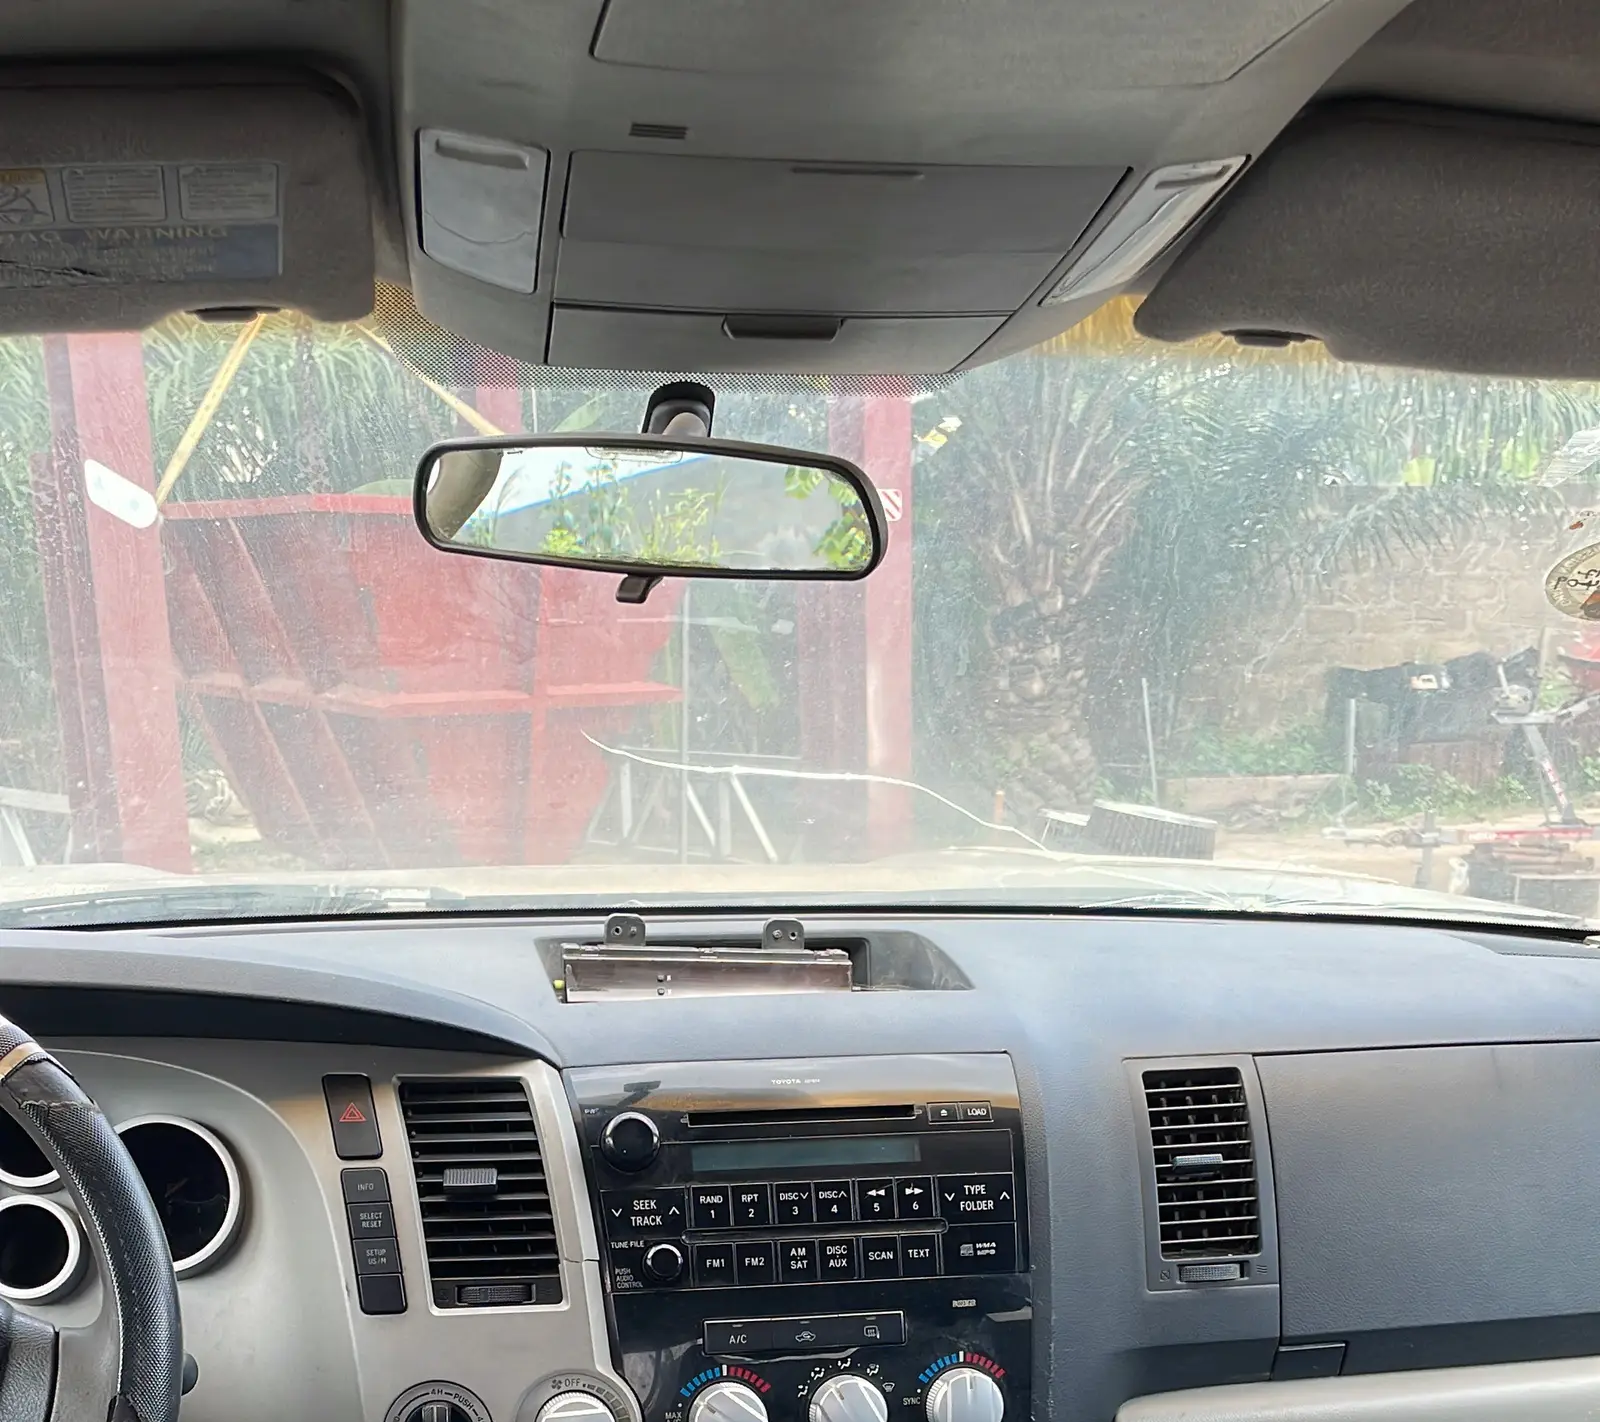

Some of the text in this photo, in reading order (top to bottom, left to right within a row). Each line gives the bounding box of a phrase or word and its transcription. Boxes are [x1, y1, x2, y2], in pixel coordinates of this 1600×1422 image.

[967, 1107, 987, 1117] LOAD
[357, 1183, 374, 1191] INFO
[964, 1185, 987, 1195] TYPE
[741, 1194, 759, 1203] RPT
[779, 1192, 799, 1201] DISC
[818, 1190, 838, 1199] DISC
[700, 1195, 723, 1204] RAND
[633, 1200, 657, 1211] SEEK
[830, 1205, 838, 1214] 4
[873, 1203, 880, 1212] 5
[912, 1201, 919, 1210] 6
[960, 1200, 994, 1212] FOLDER
[710, 1210, 715, 1219] 1
[748, 1209, 755, 1218] 2
[792, 1206, 799, 1215] 3
[359, 1212, 383, 1221] SELECT
[361, 1220, 383, 1228] RESET
[630, 1216, 663, 1227] TRACK
[366, 1248, 387, 1257] SETUP
[790, 1247, 806, 1257] AM
[826, 1245, 847, 1254] DISC
[908, 1249, 930, 1259] TEXT
[868, 1251, 893, 1260] SCAN
[706, 1259, 725, 1268] FM1
[745, 1257, 765, 1267] FM2
[790, 1260, 808, 1269] SAT
[828, 1258, 848, 1268] AUX
[615, 1267, 631, 1275] PUSH
[616, 1274, 634, 1282] AUDIO
[616, 1281, 643, 1289] CONTROL
[729, 1334, 747, 1344] A/C
[564, 1377, 581, 1388] OFF
[453, 1393, 474, 1411] PUSH
[902, 1397, 921, 1406] SYNC
[665, 1411, 682, 1419] MAX
